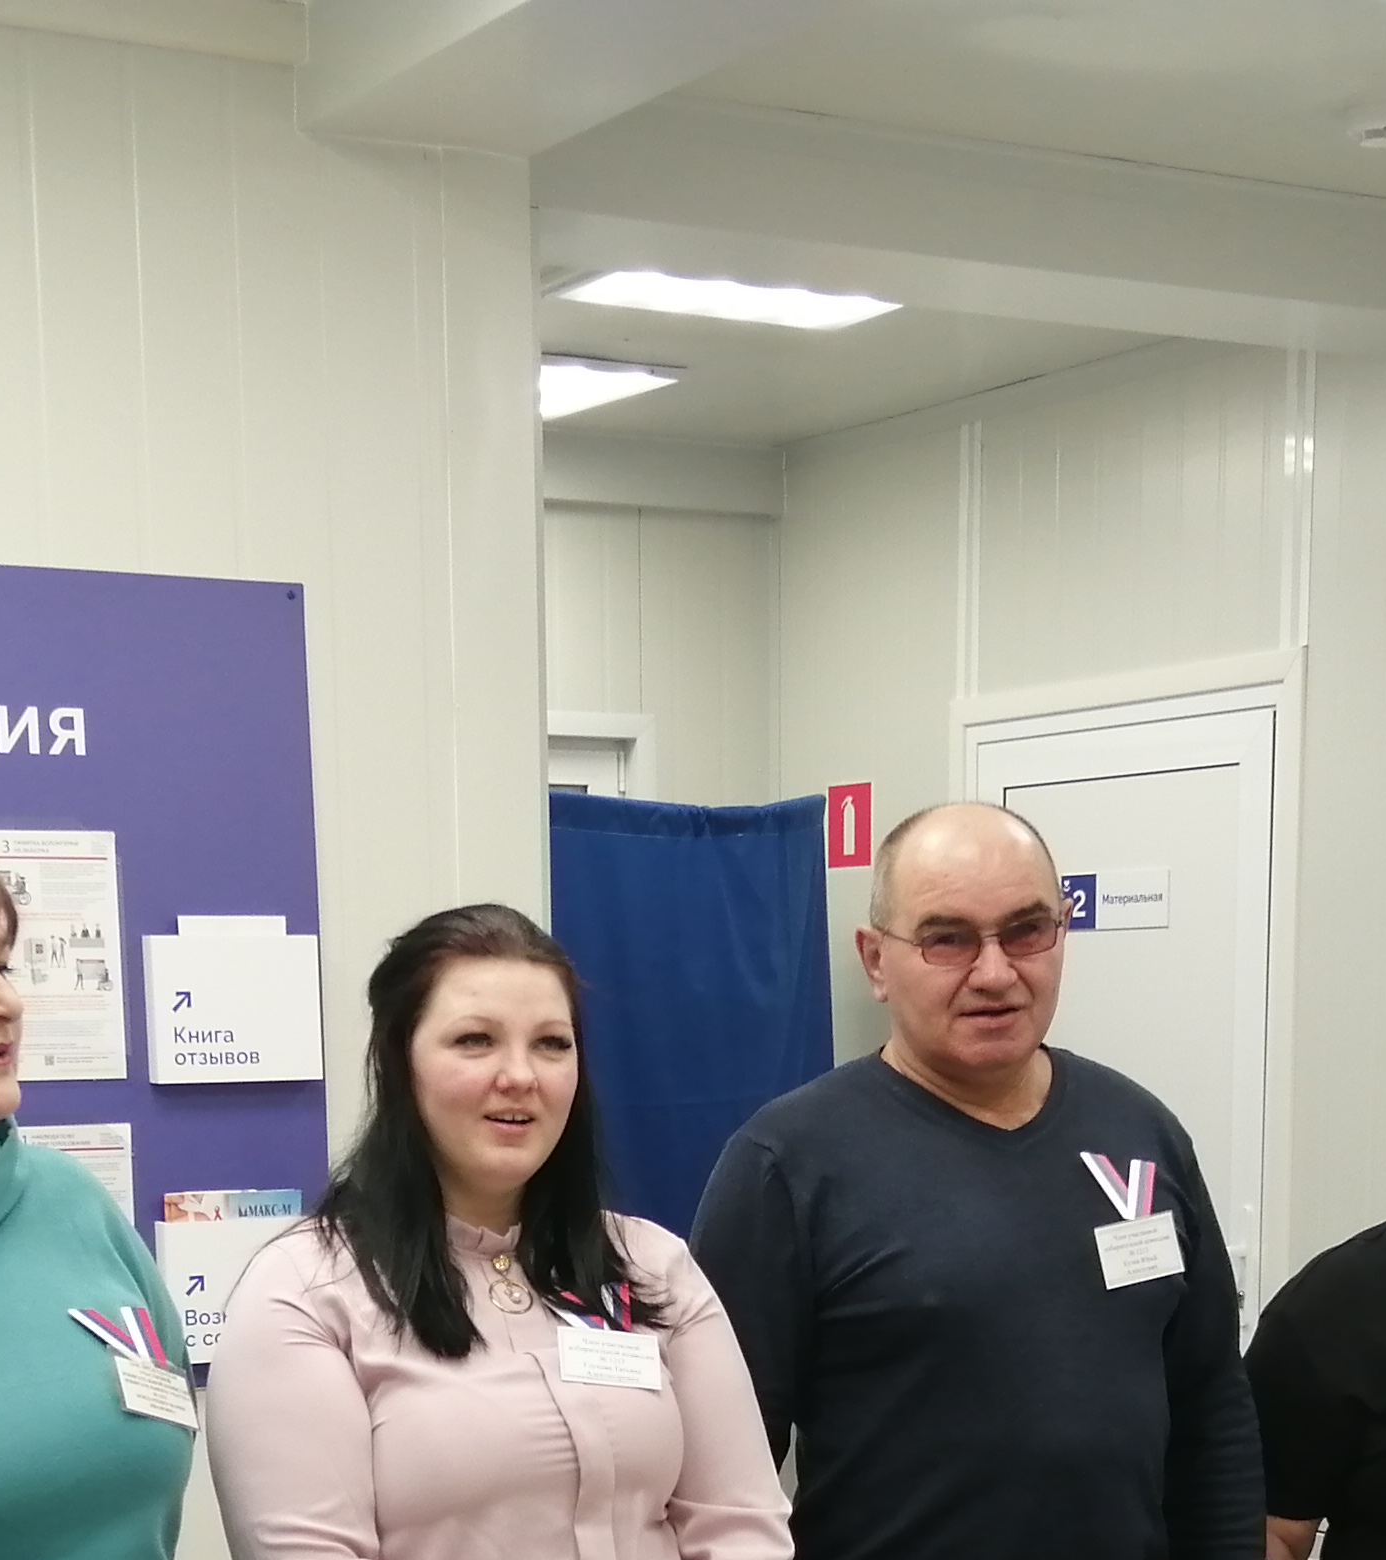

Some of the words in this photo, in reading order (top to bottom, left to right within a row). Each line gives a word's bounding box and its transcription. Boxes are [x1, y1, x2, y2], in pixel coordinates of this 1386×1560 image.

[1072, 889, 1086, 918] 2
[1101, 893, 1163, 906] Материальная
[173, 1026, 235, 1044] Книга
[174, 1051, 261, 1066] отзывов
[247, 1203, 292, 1218] МАКС-М
